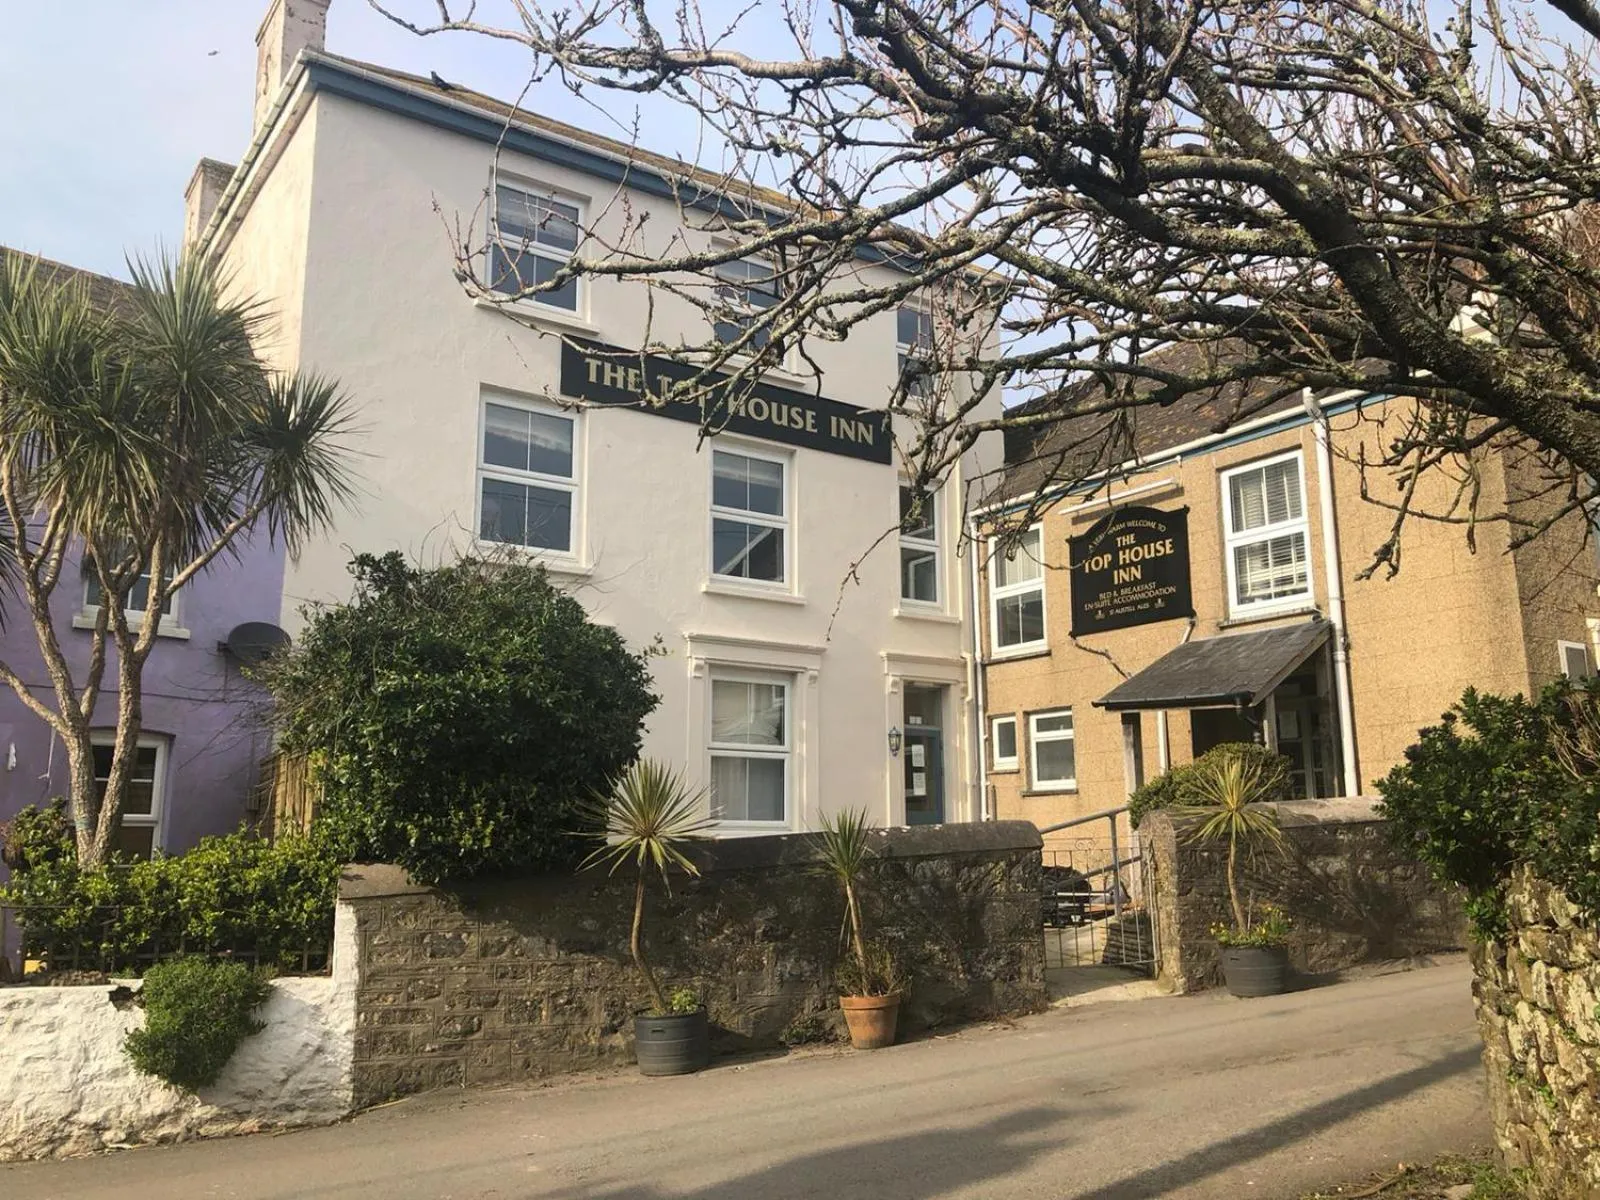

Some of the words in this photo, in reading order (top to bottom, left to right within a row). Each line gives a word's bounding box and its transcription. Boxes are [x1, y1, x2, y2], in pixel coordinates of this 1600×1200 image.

[584, 357, 642, 394] THE
[727, 391, 818, 433] HOUSE
[830, 415, 874, 446] INN
[1126, 519, 1157, 529] WELCOME
[1157, 522, 1167, 533] TO
[1116, 533, 1137, 548] THE
[1083, 553, 1112, 574] TOP
[1118, 538, 1175, 565] HOUSE
[1113, 564, 1142, 586] INN
[1099, 591, 1112, 601] BED
[1120, 581, 1157, 596] BREAKFAST
[1114, 585, 1177, 605] ACCOMMODATION
